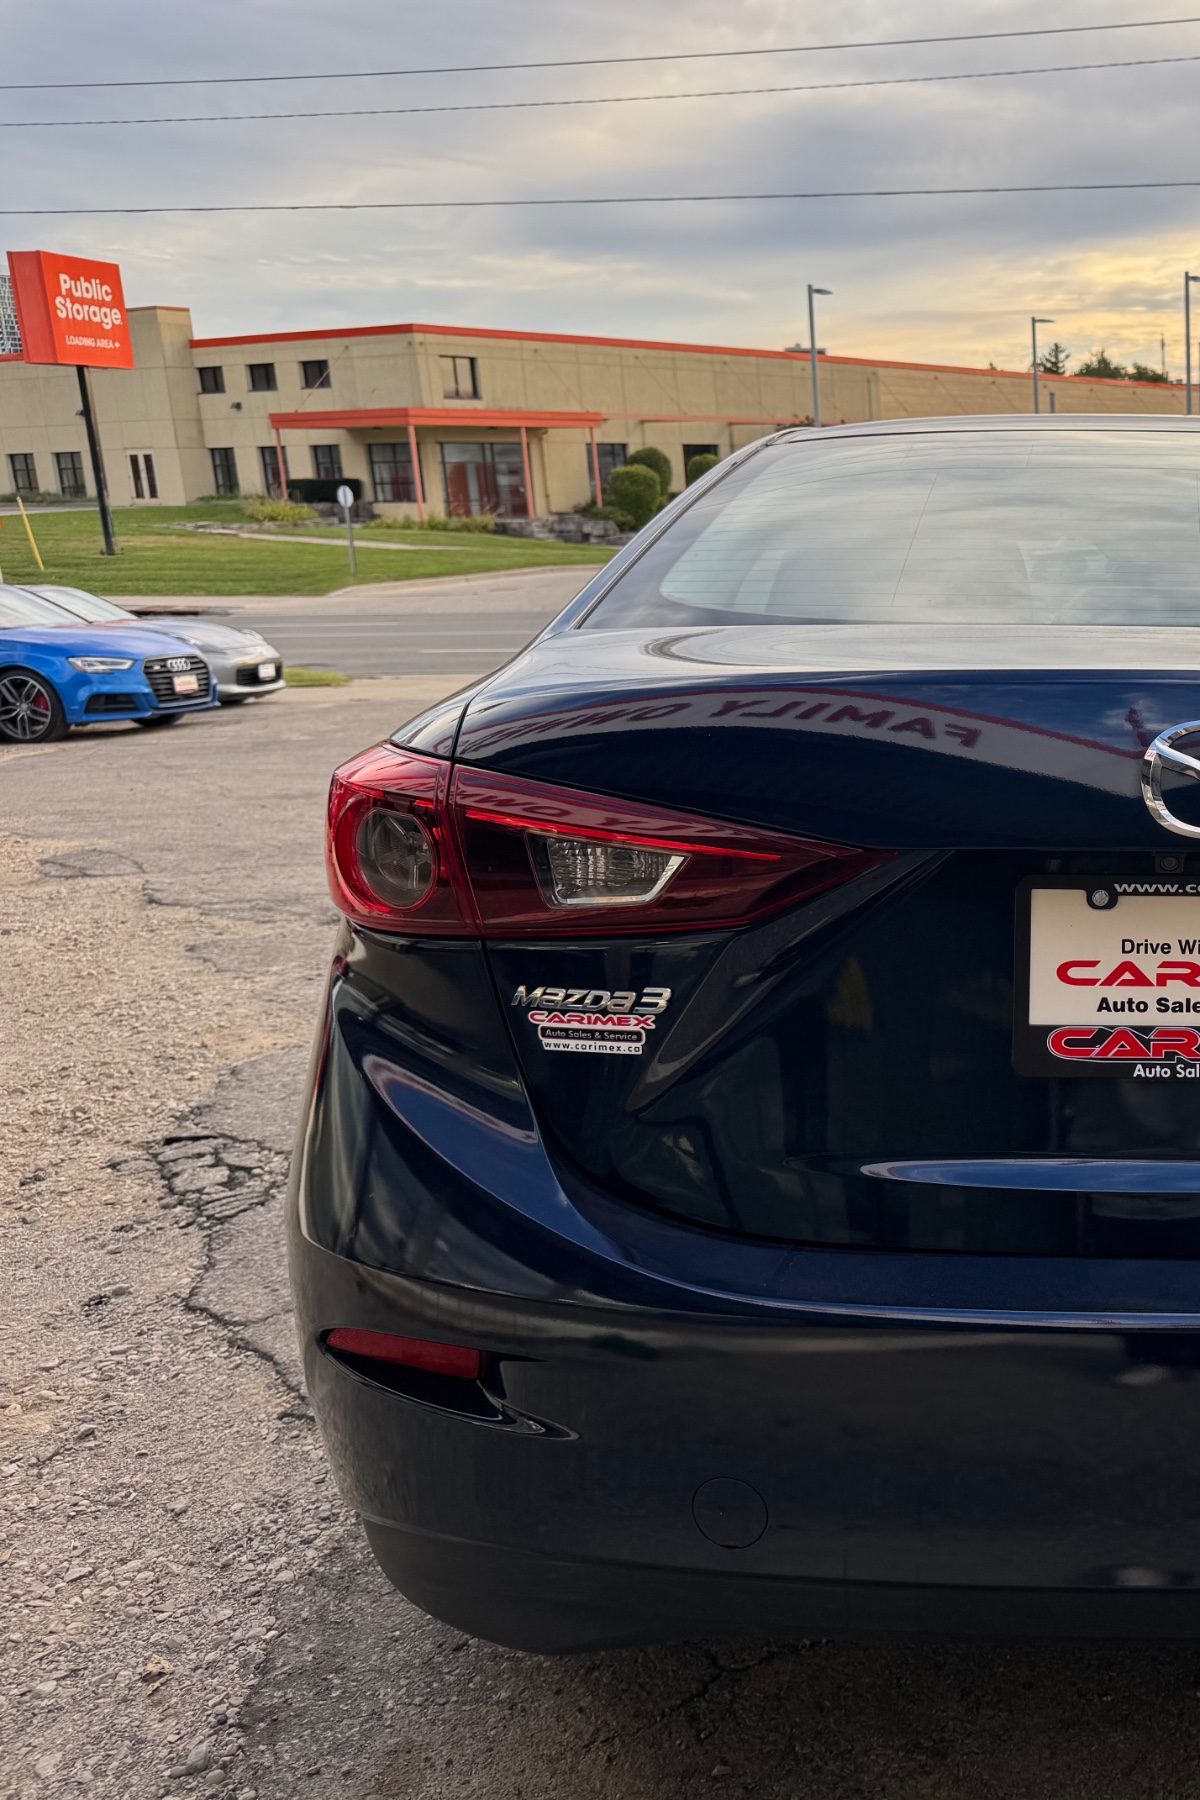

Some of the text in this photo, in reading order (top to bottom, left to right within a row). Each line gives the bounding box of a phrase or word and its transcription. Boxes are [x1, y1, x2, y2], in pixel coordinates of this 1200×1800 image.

[59, 273, 112, 301] Public
[55, 296, 122, 330] Storage
[65, 335, 114, 349] LOADING AREA
[1121, 939, 1172, 955] Drive
[1097, 997, 1149, 1013] Auto
[529, 1012, 654, 1028] CARIMEX
[545, 1029, 638, 1041] Auto Sales & Service
[543, 1041, 641, 1053] www.carimex.ca
[1133, 1064, 1171, 1078] Auto
